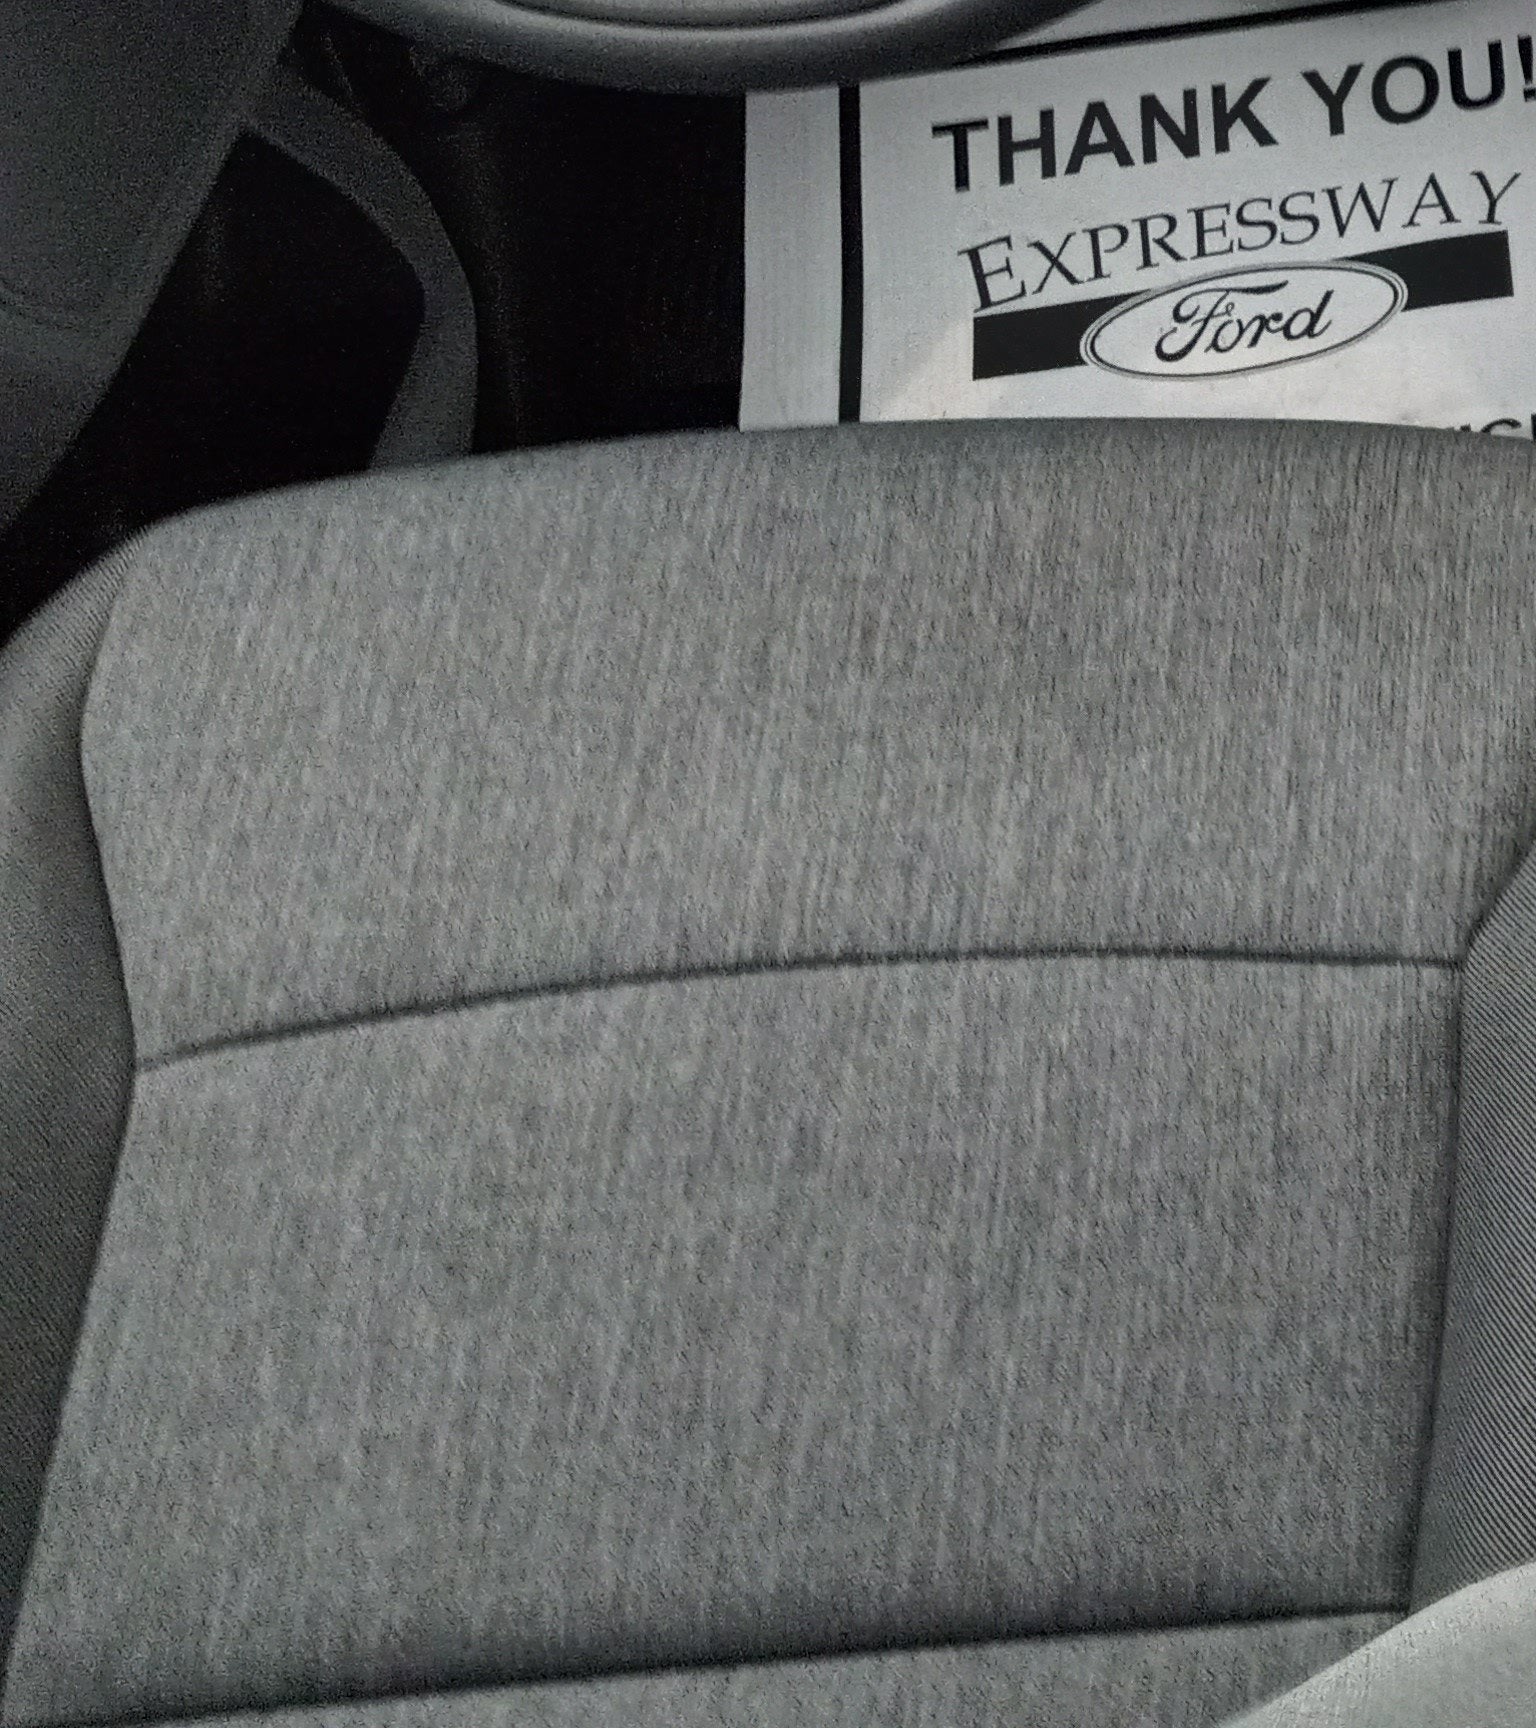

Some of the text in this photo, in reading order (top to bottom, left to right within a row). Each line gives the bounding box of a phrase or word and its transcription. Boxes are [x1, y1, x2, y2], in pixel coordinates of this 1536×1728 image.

[932, 77, 1279, 193] THANK
[957, 170, 1522, 314] EXPRESSWAY
[1154, 279, 1335, 364] Ford
